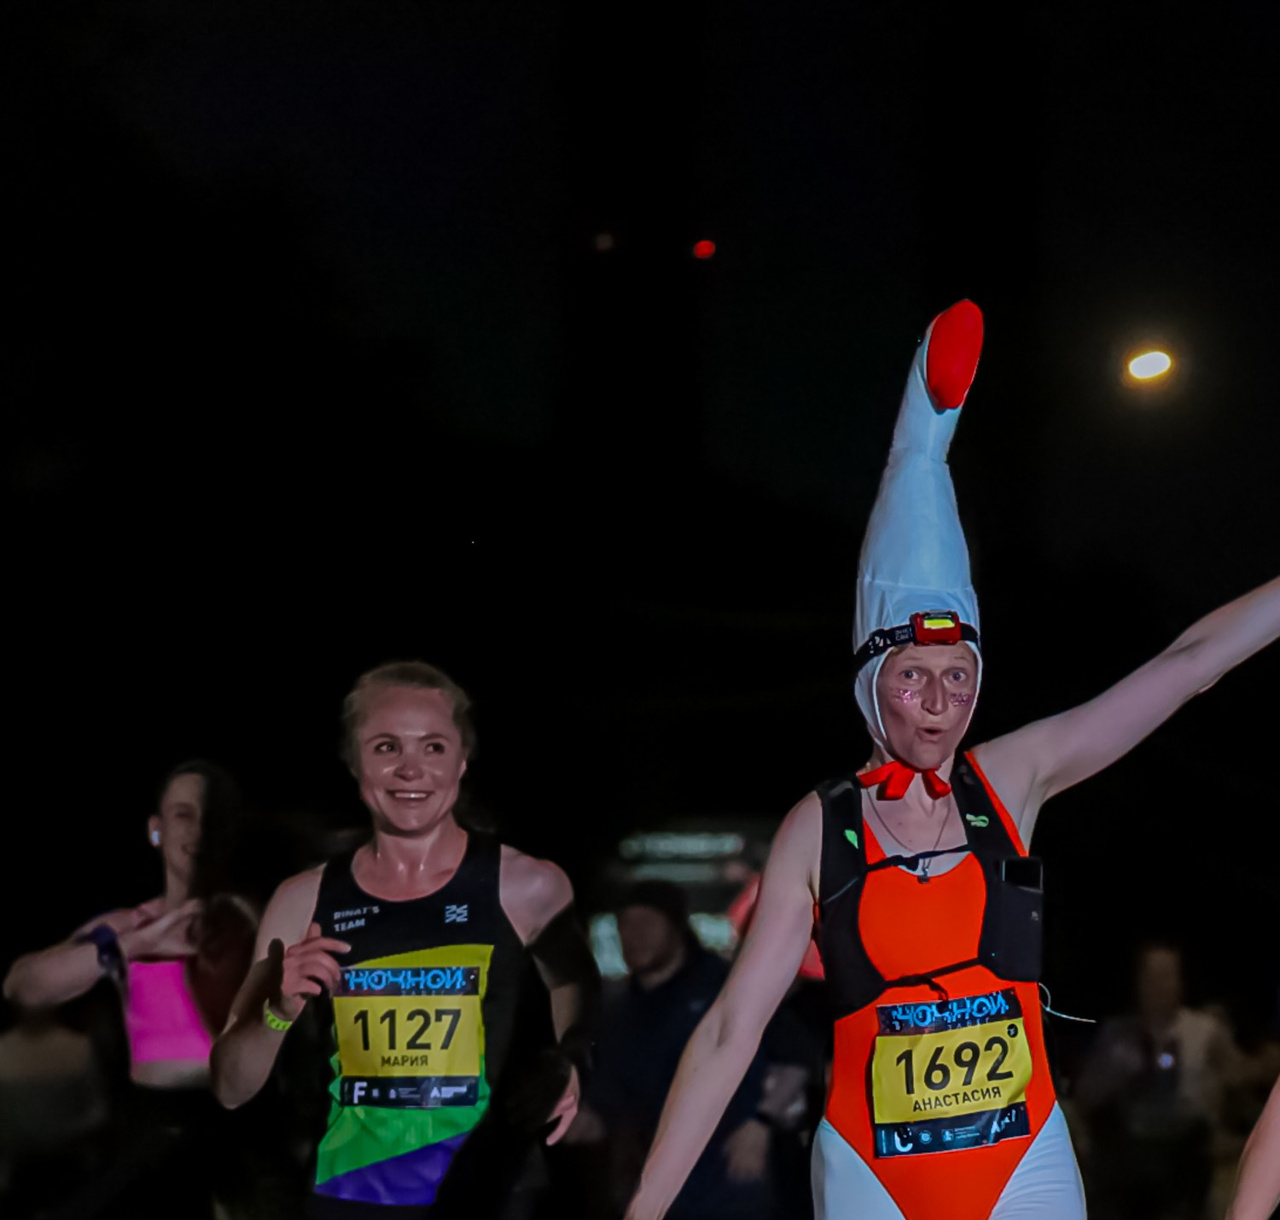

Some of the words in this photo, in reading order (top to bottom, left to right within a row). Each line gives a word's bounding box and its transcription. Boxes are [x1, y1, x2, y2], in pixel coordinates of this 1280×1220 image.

[334, 918, 366, 932] TEAM
[345, 966, 466, 991] НОЧНОЙ
[353, 1008, 462, 1051] 1127
[381, 1054, 428, 1068] МАРИЯ
[896, 1036, 1014, 1095] 1692
[353, 1081, 367, 1104] F
[913, 1086, 1002, 1112] АНАСТАСИЯ
